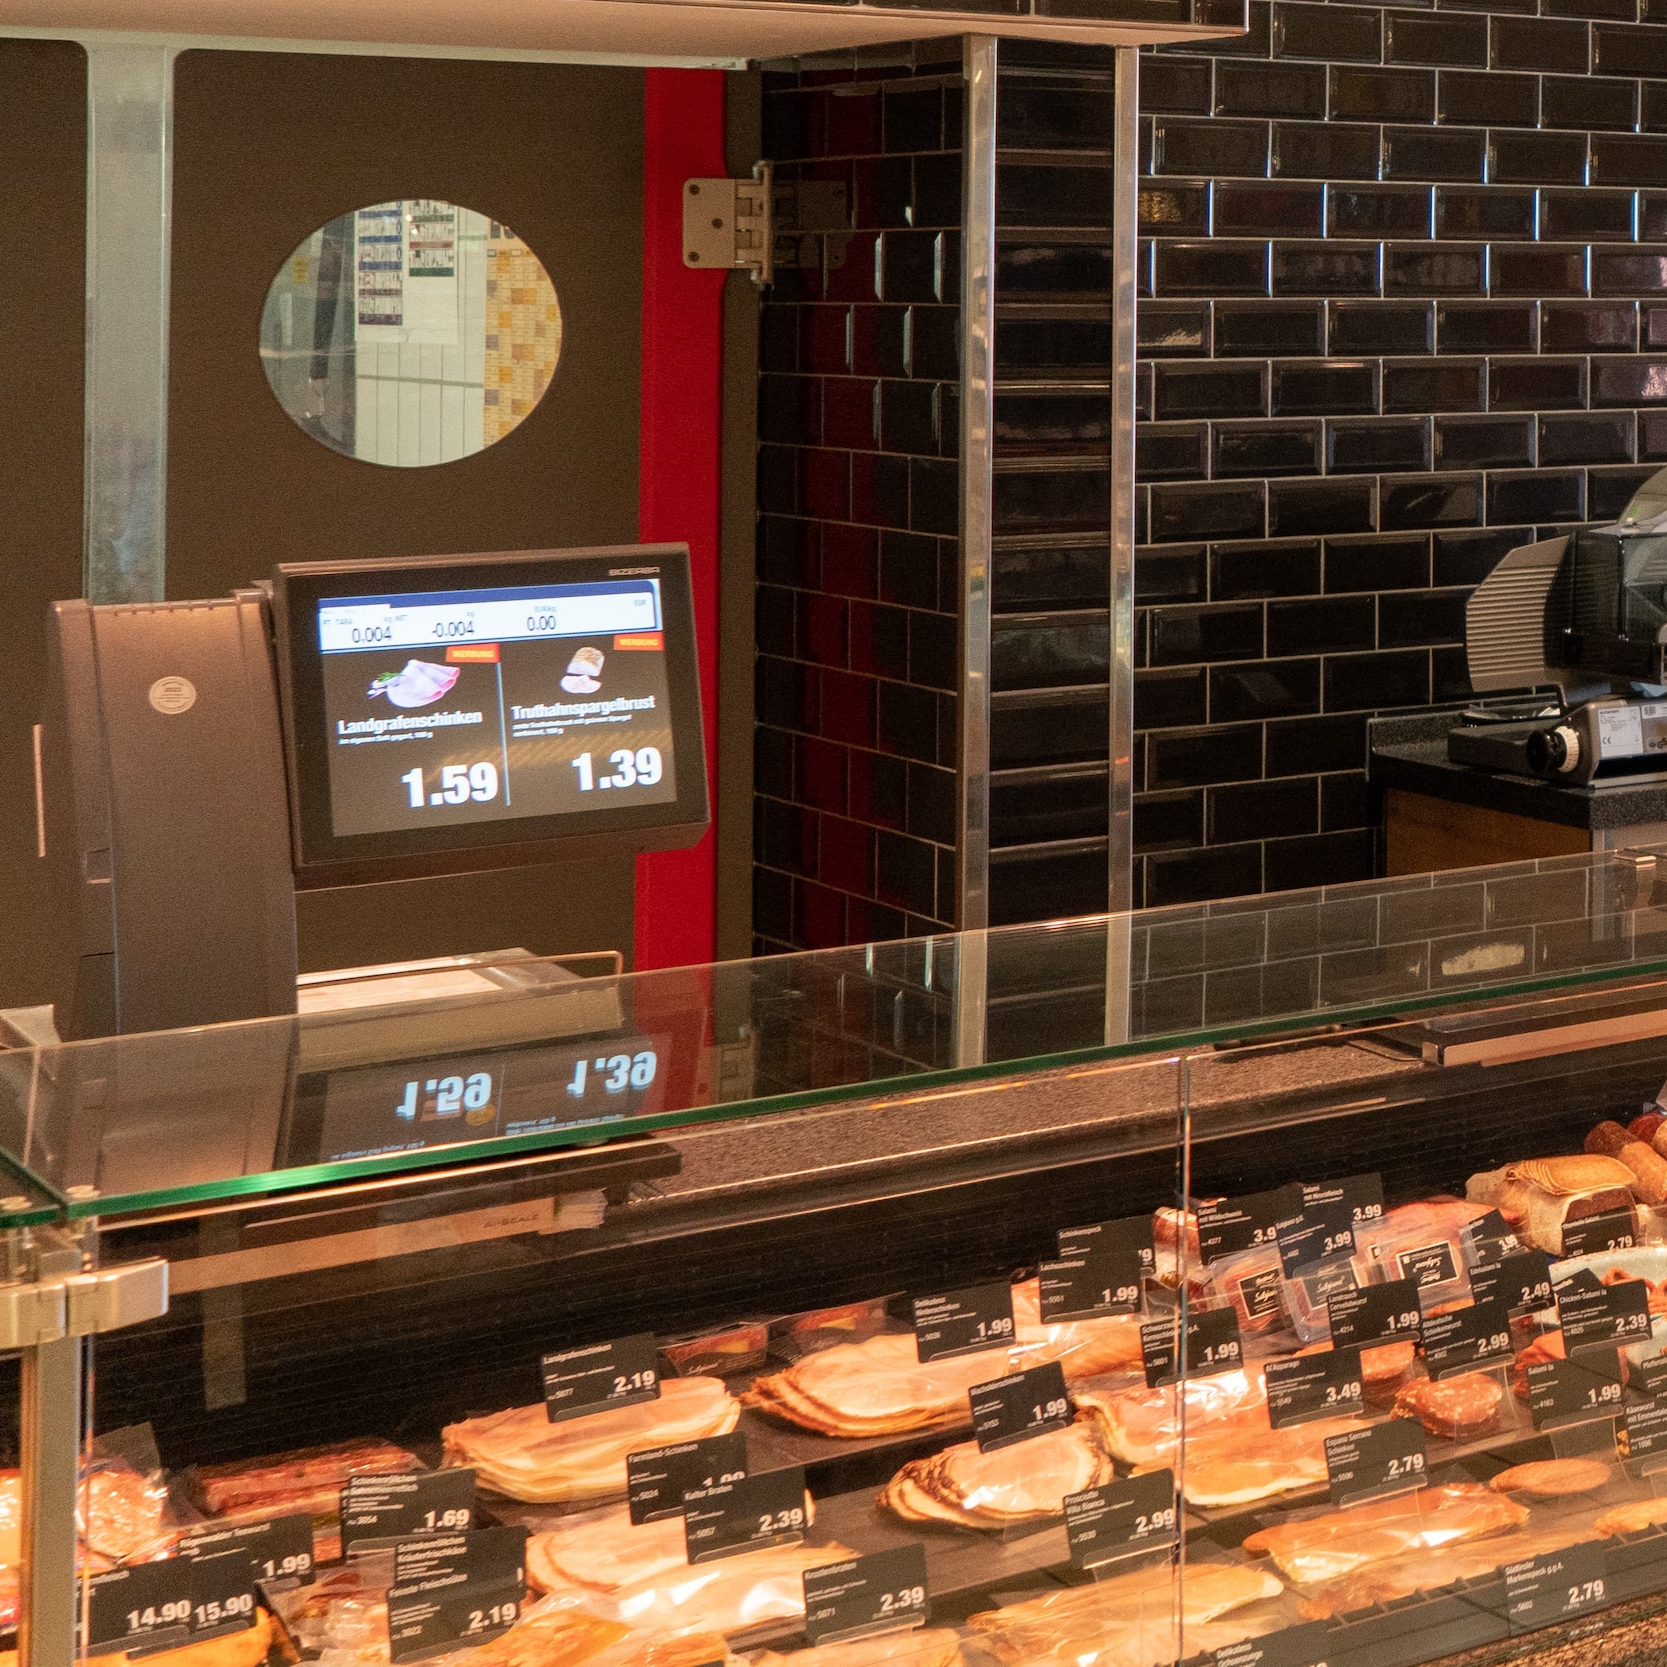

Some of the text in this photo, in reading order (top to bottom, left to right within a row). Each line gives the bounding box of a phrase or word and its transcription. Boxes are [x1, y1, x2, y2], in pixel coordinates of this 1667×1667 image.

[608, 567, 660, 577] BIZERBA
[352, 615, 557, 644] 0.004 -0.004 0.00
[619, 636, 659, 647] WERBUNG
[452, 648, 495, 659] WERBUNG
[511, 695, 656, 721] Truthahnspargelbrust
[338, 710, 483, 735] Landgrafenschinken
[570, 746, 663, 792] 1.39
[401, 761, 498, 808] 1.59
[1353, 1204, 1382, 1221] 3.99
[1324, 1230, 1352, 1251] 3.99
[1498, 1234, 1518, 1250] 3.99
[1607, 1234, 1633, 1251] 2.79
[1102, 1286, 1138, 1303] 1.99
[1521, 1281, 1551, 1301] 2.49
[977, 1317, 1012, 1338] 1.99
[1387, 1311, 1420, 1329] 1.99
[1615, 1313, 1648, 1332] 2.39
[1204, 1341, 1239, 1362] 1.99
[1477, 1332, 1509, 1353] 2.99
[614, 1370, 655, 1394] 2.19
[1325, 1382, 1361, 1403] 3.49
[1587, 1383, 1622, 1404] 1.99
[1032, 1398, 1068, 1421] 1.99
[1388, 1453, 1424, 1476] 2.79
[424, 1509, 470, 1528] 1.69
[759, 1507, 803, 1532] 2.39
[1136, 1508, 1175, 1533] 2.99
[262, 1553, 312, 1577] 1.99
[880, 1587, 925, 1612] 2.39
[1568, 1579, 1605, 1605] 2.79
[127, 1599, 191, 1629] 14.90
[194, 1594, 253, 1624] 15.90
[468, 1602, 517, 1630] 2.19
